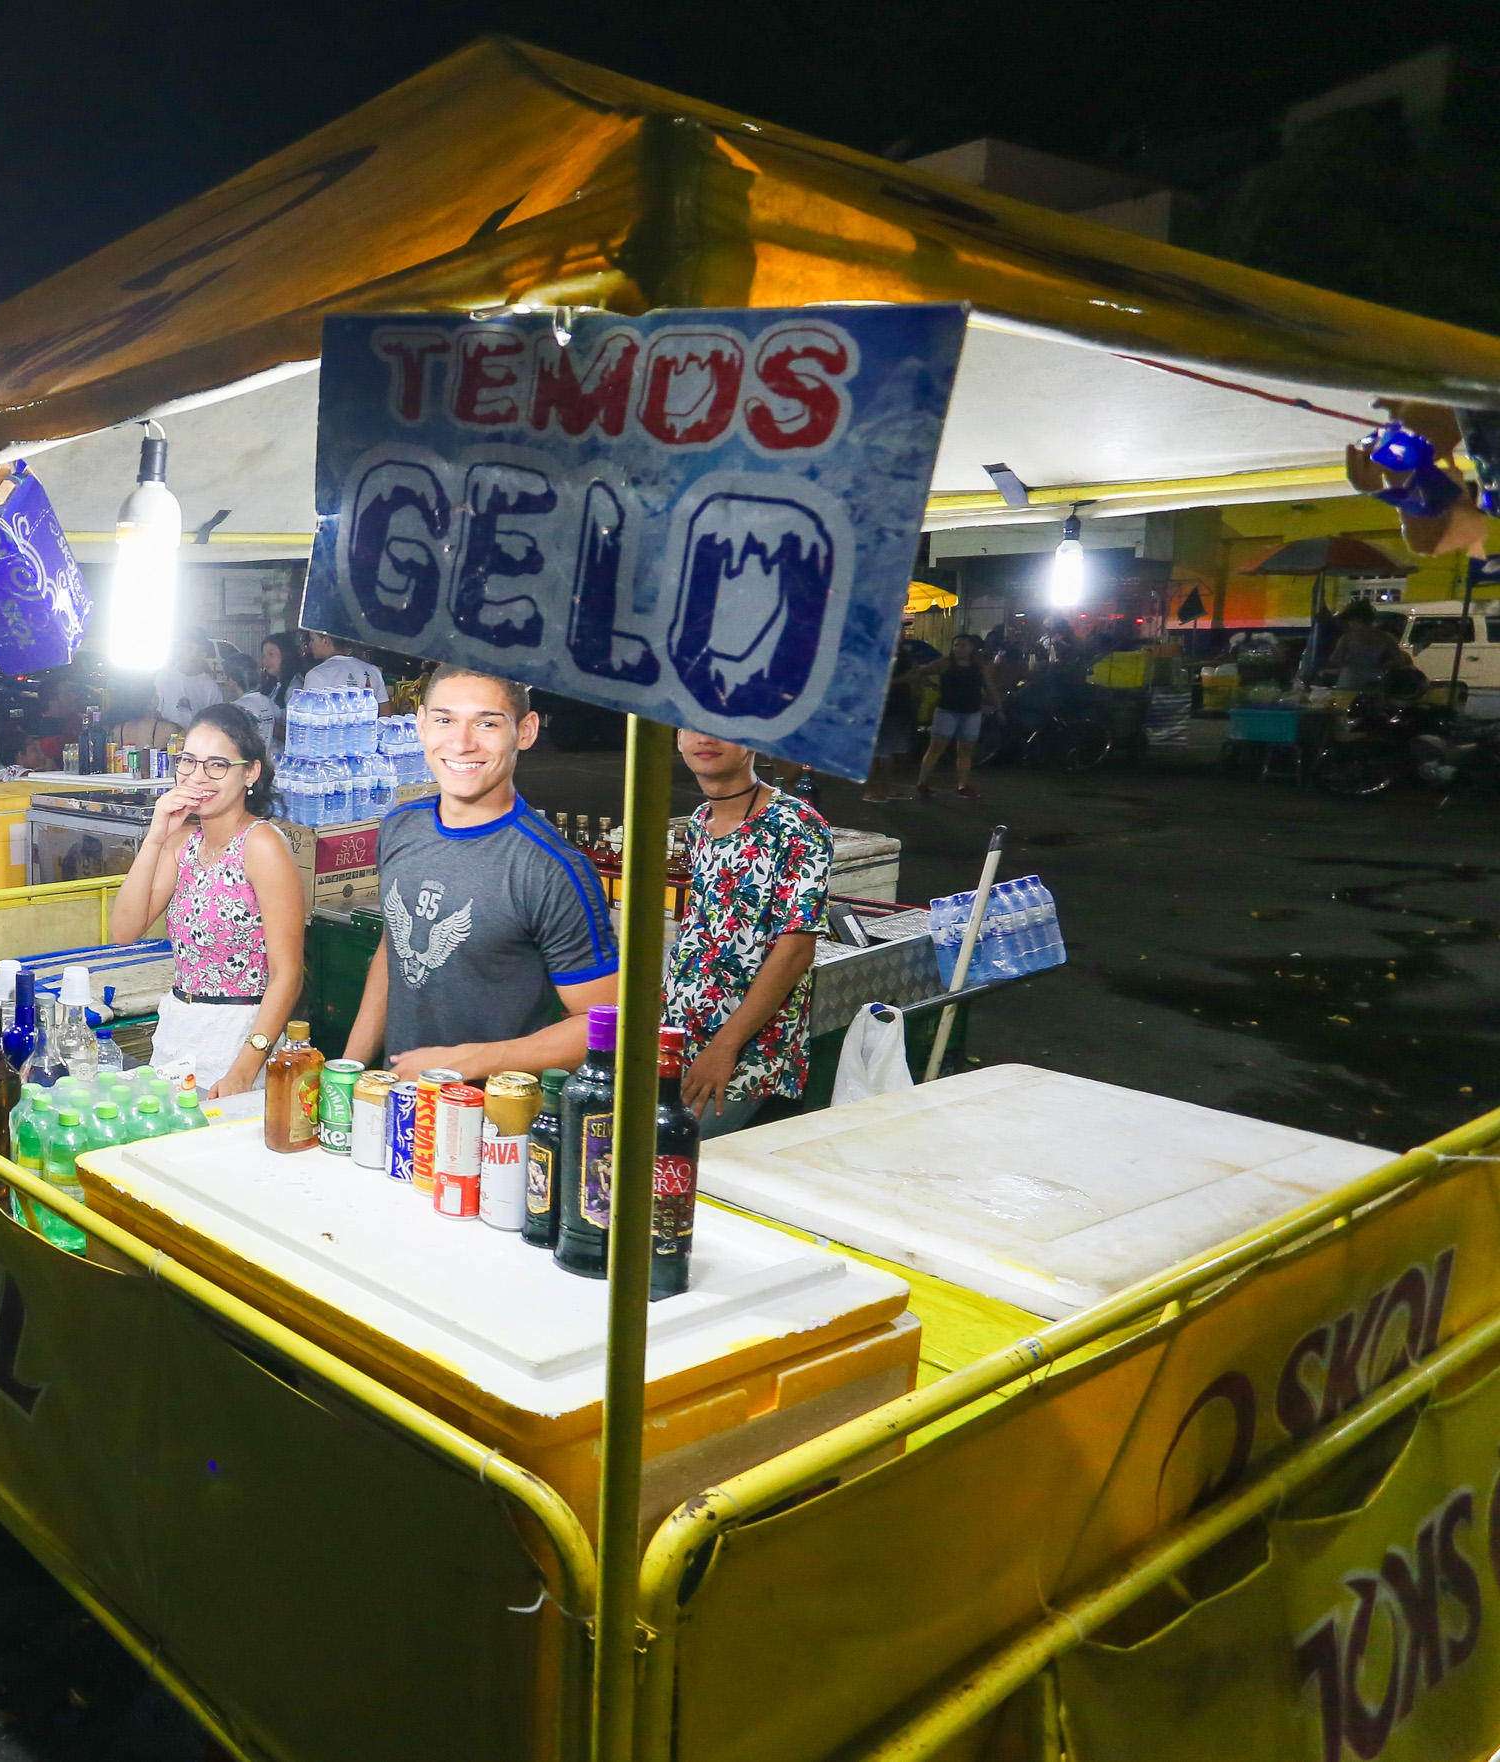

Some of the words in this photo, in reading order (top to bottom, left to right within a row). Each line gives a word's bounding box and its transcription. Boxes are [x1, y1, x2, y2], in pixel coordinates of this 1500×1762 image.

[381, 327, 848, 450] TEMOS
[348, 458, 835, 721] GELO
[335, 848, 367, 867] BRAZ
[340, 835, 367, 854] SÃO
[415, 889, 442, 921] 95
[413, 1087, 437, 1178] DEVASSA
[653, 1160, 691, 1179] SÃO
